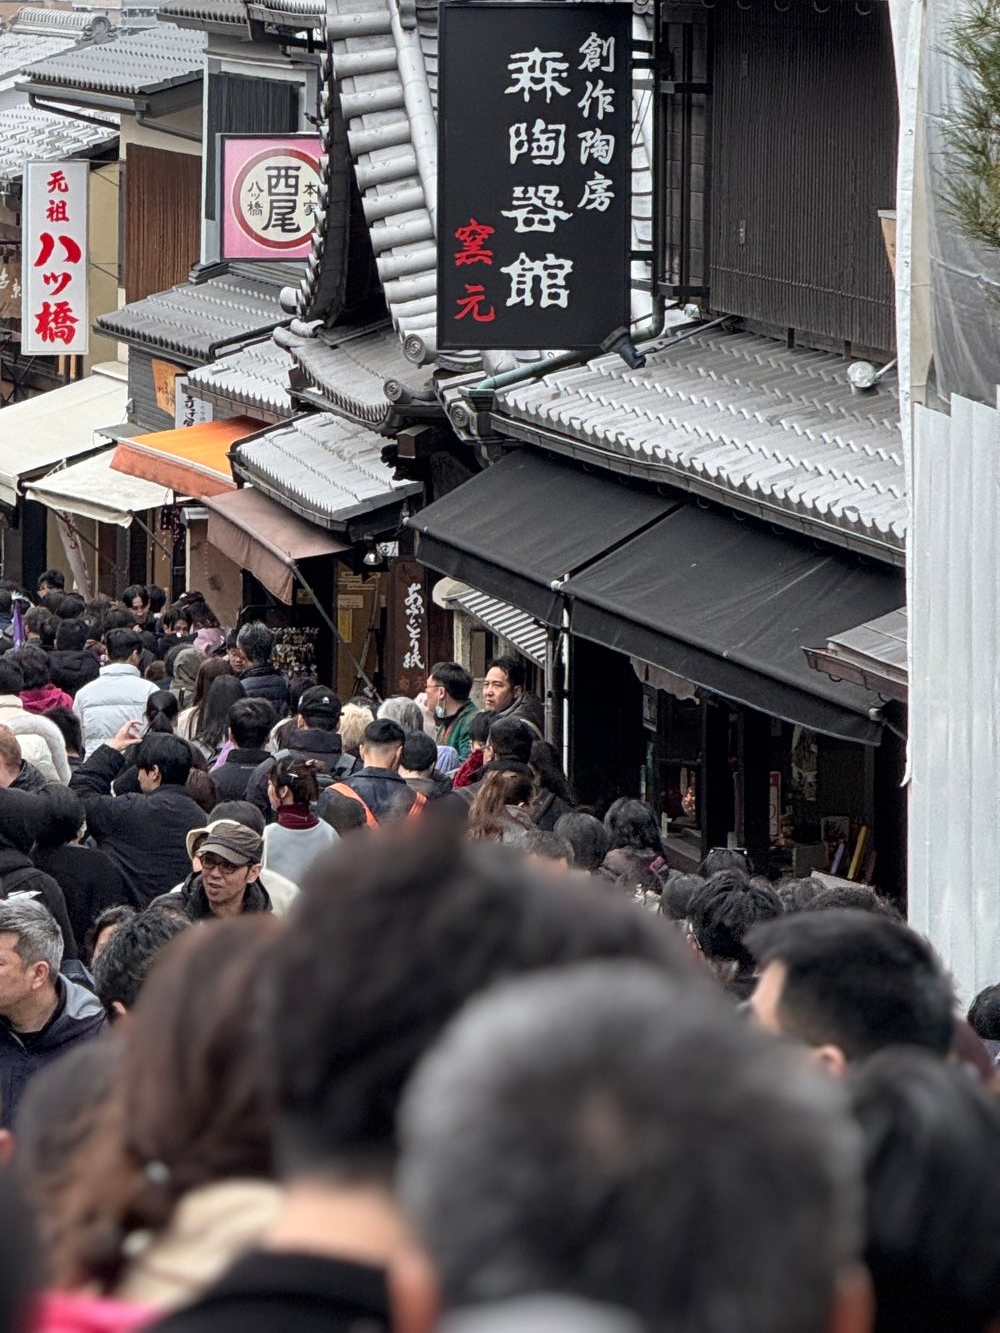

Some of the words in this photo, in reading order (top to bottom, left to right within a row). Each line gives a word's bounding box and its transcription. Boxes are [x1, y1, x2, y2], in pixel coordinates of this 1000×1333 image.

[577, 31, 615, 212] 創作陶房
[46, 170, 70, 222] 元祖
[261, 165, 302, 233] 西尾
[303, 181, 318, 216] 本家
[500, 47, 574, 309] 森陶器館
[454, 218, 496, 322] 窯元
